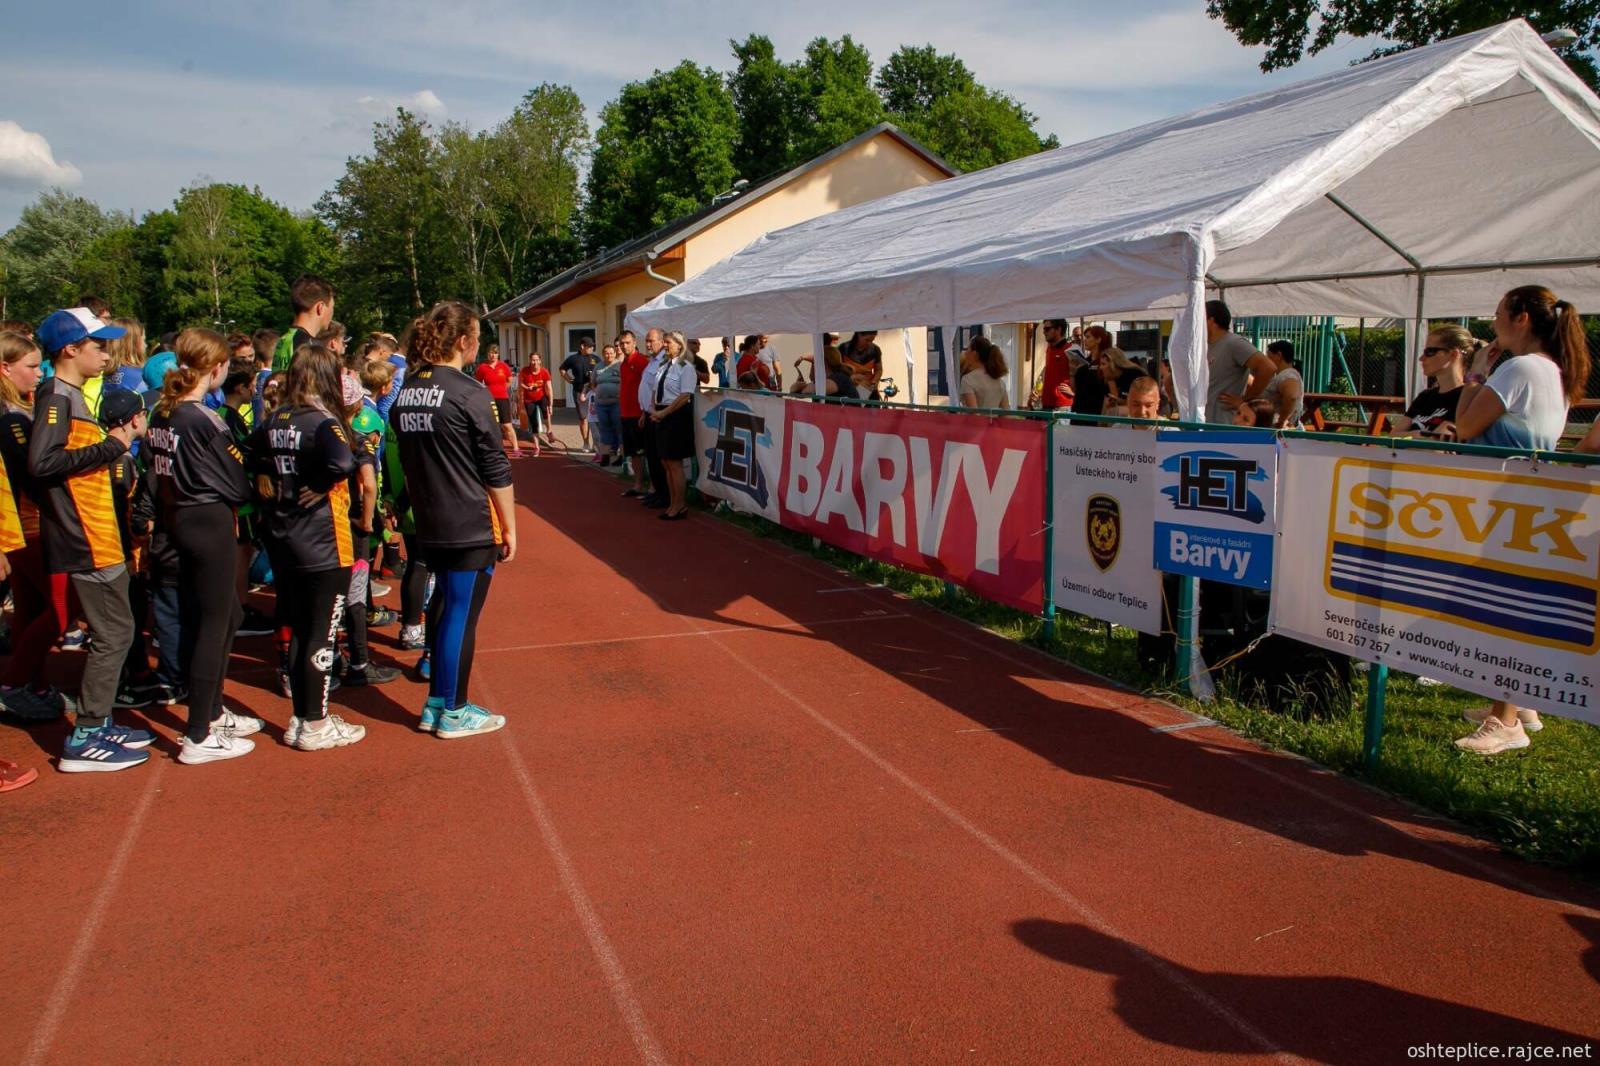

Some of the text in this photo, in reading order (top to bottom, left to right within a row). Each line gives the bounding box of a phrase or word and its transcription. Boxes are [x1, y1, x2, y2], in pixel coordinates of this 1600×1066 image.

[397, 384, 445, 407] HASIČI
[400, 412, 434, 432] OSEK
[1059, 446, 1092, 460] Hasičský
[1094, 449, 1136, 465] záchranný
[1075, 464, 1138, 484] Ústeckého kraje
[786, 420, 1028, 575] BARVY
[1179, 456, 1257, 512] HET
[1170, 530, 1251, 579] Barvy
[1062, 576, 1148, 610] Územní odbor Teplice
[1324, 610, 1594, 688] Severočeské vodovody a kanalizace, a.s.
[1326, 627, 1588, 708] 601 267 267 www.scvk.cz 840 111 111
